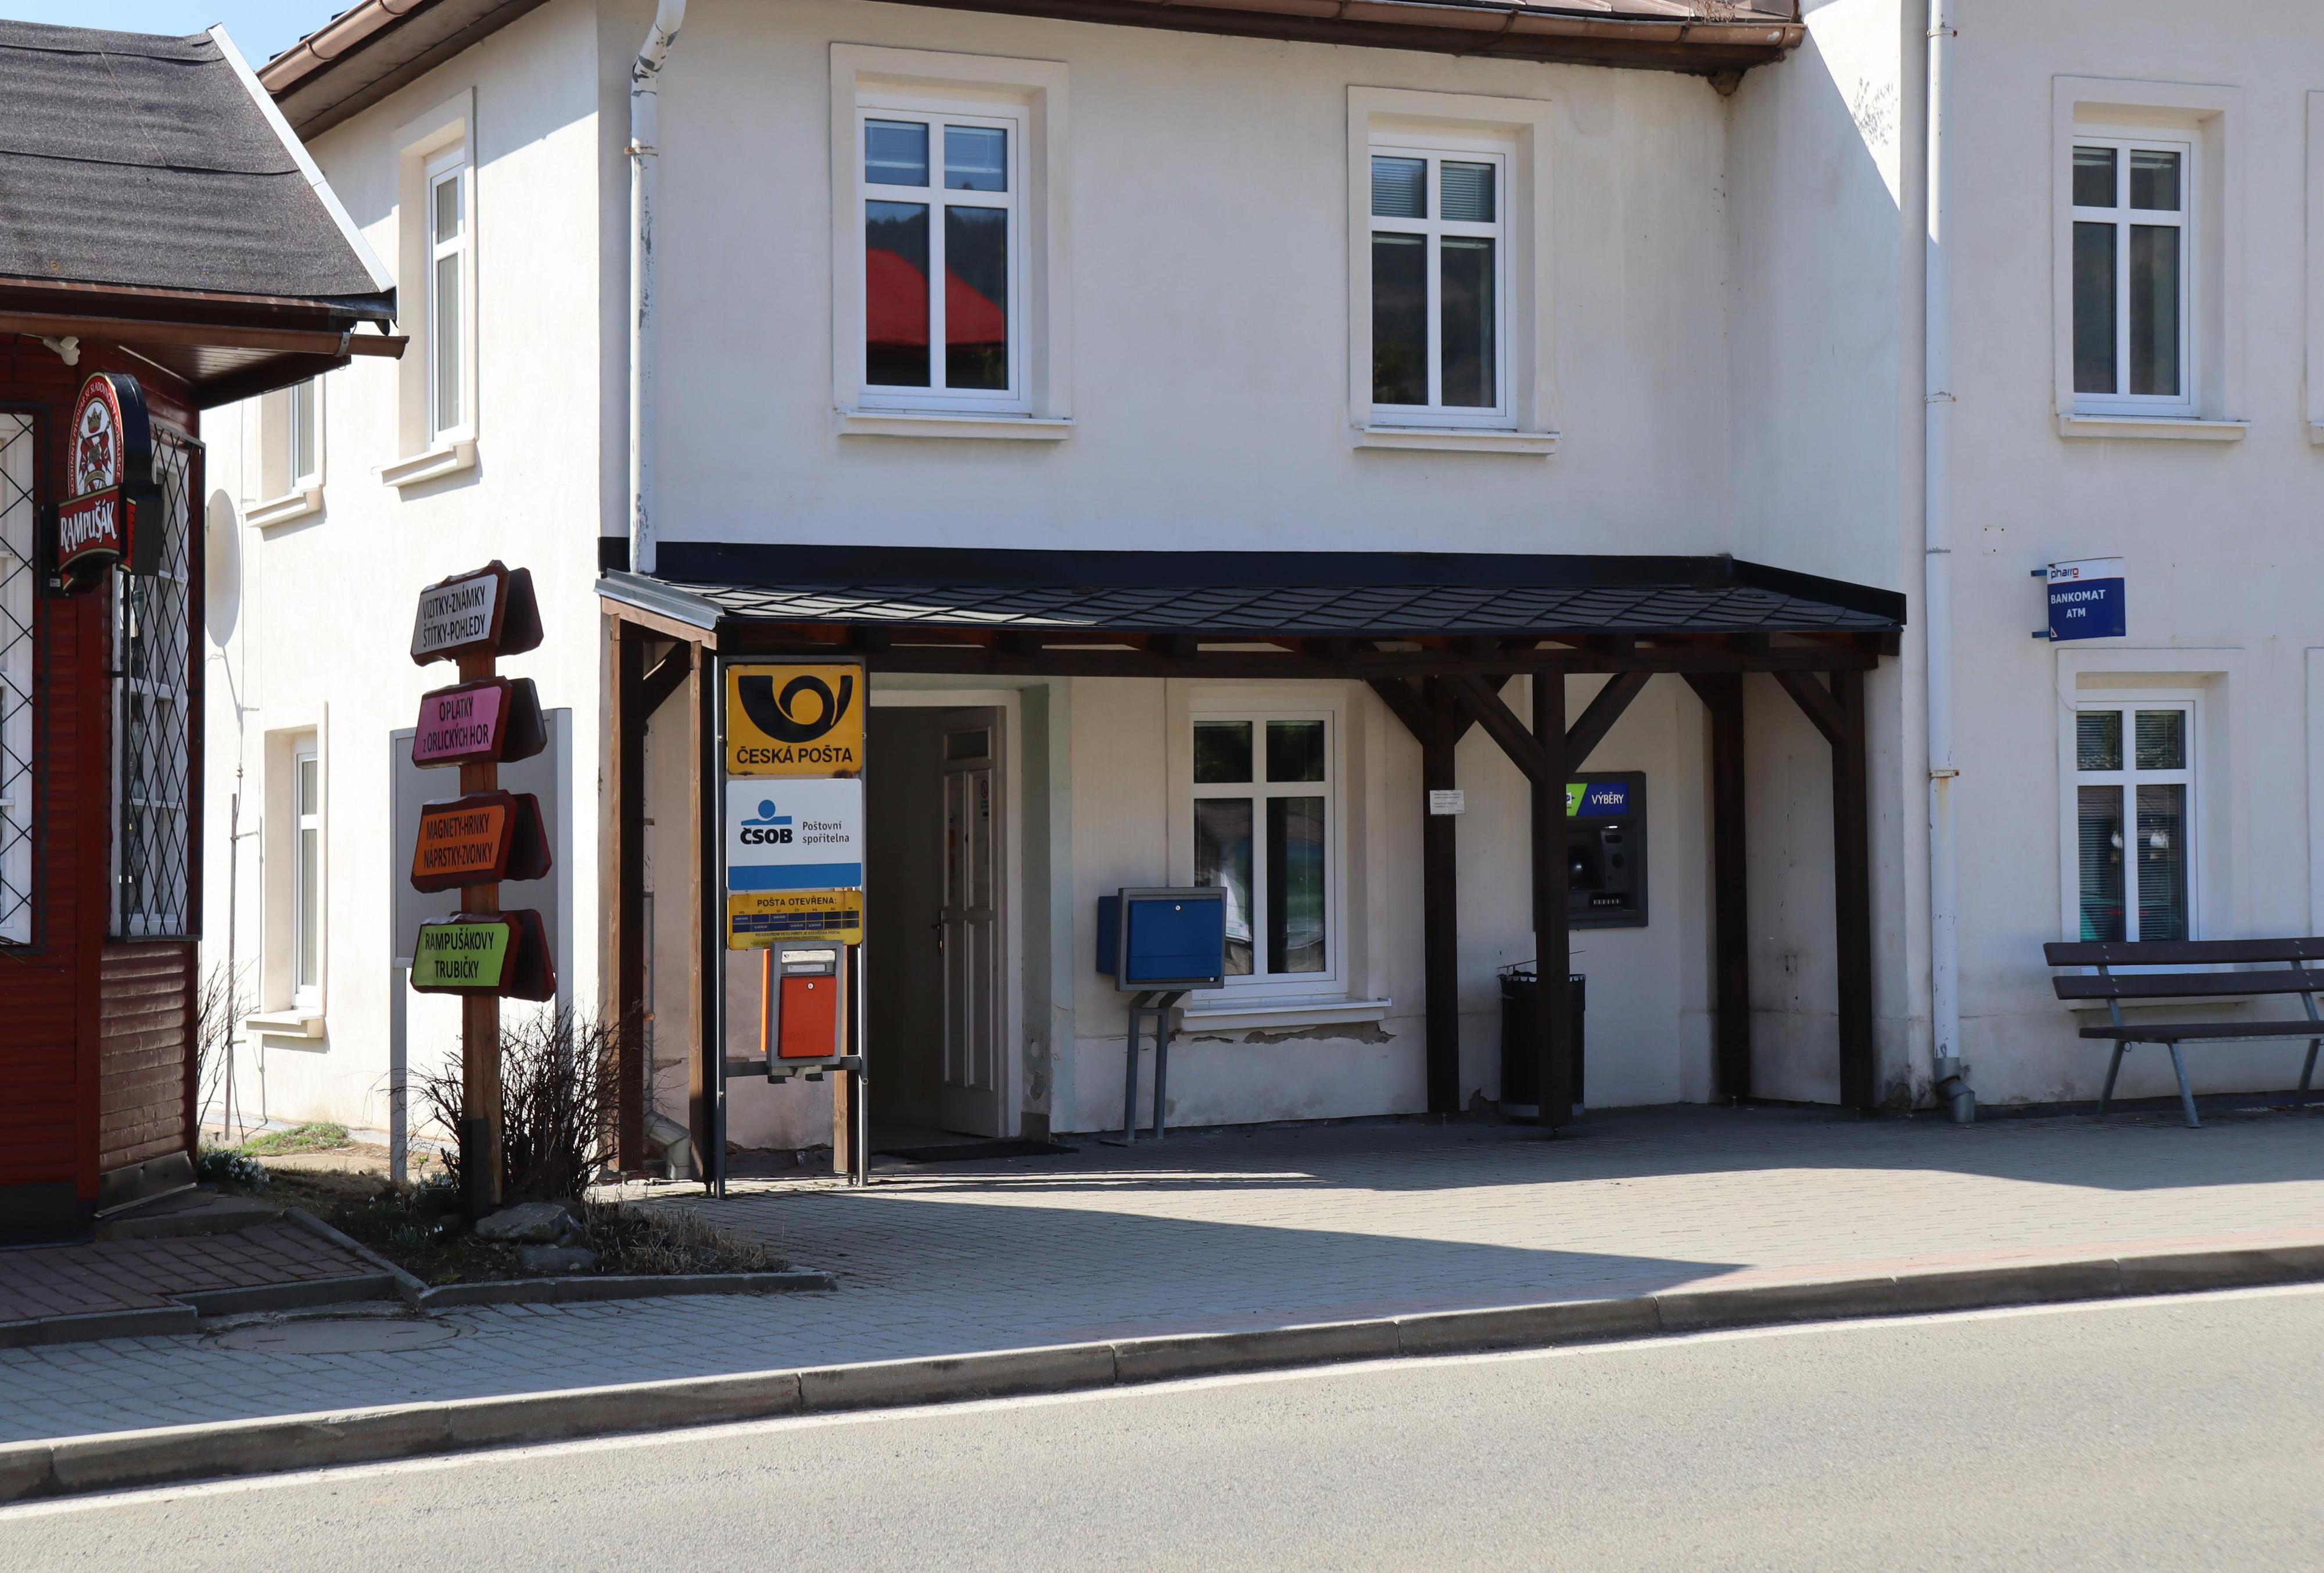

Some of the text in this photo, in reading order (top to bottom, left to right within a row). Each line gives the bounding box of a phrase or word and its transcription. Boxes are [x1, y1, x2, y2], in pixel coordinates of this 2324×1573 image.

[60, 499, 117, 553] RAMPUŠÁK
[2051, 568, 2079, 579] pharro
[2051, 590, 2106, 604] BANKOMAT
[2066, 608, 2086, 618] ATM
[423, 614, 485, 647] ŠTÍTKY-POHLEDY
[427, 723, 468, 752] ORLICKÝCH
[470, 723, 489, 745] HOR
[737, 745, 853, 764] ČESKÁ POŠTA
[1591, 791, 1624, 804] VÝBĚRY
[427, 813, 489, 840] MAGNETY-HRNKY
[802, 820, 842, 831] Poštovní
[740, 827, 792, 844] ČSOB
[802, 833, 849, 845] spořitelna
[424, 841, 492, 868] NÁPRSTKY-ZVONKY
[757, 895, 837, 906] POŠTA OTEVŘENA:
[425, 927, 494, 950] RAMPUŠÁKOVY
[435, 956, 479, 979] TRUBIČKY
